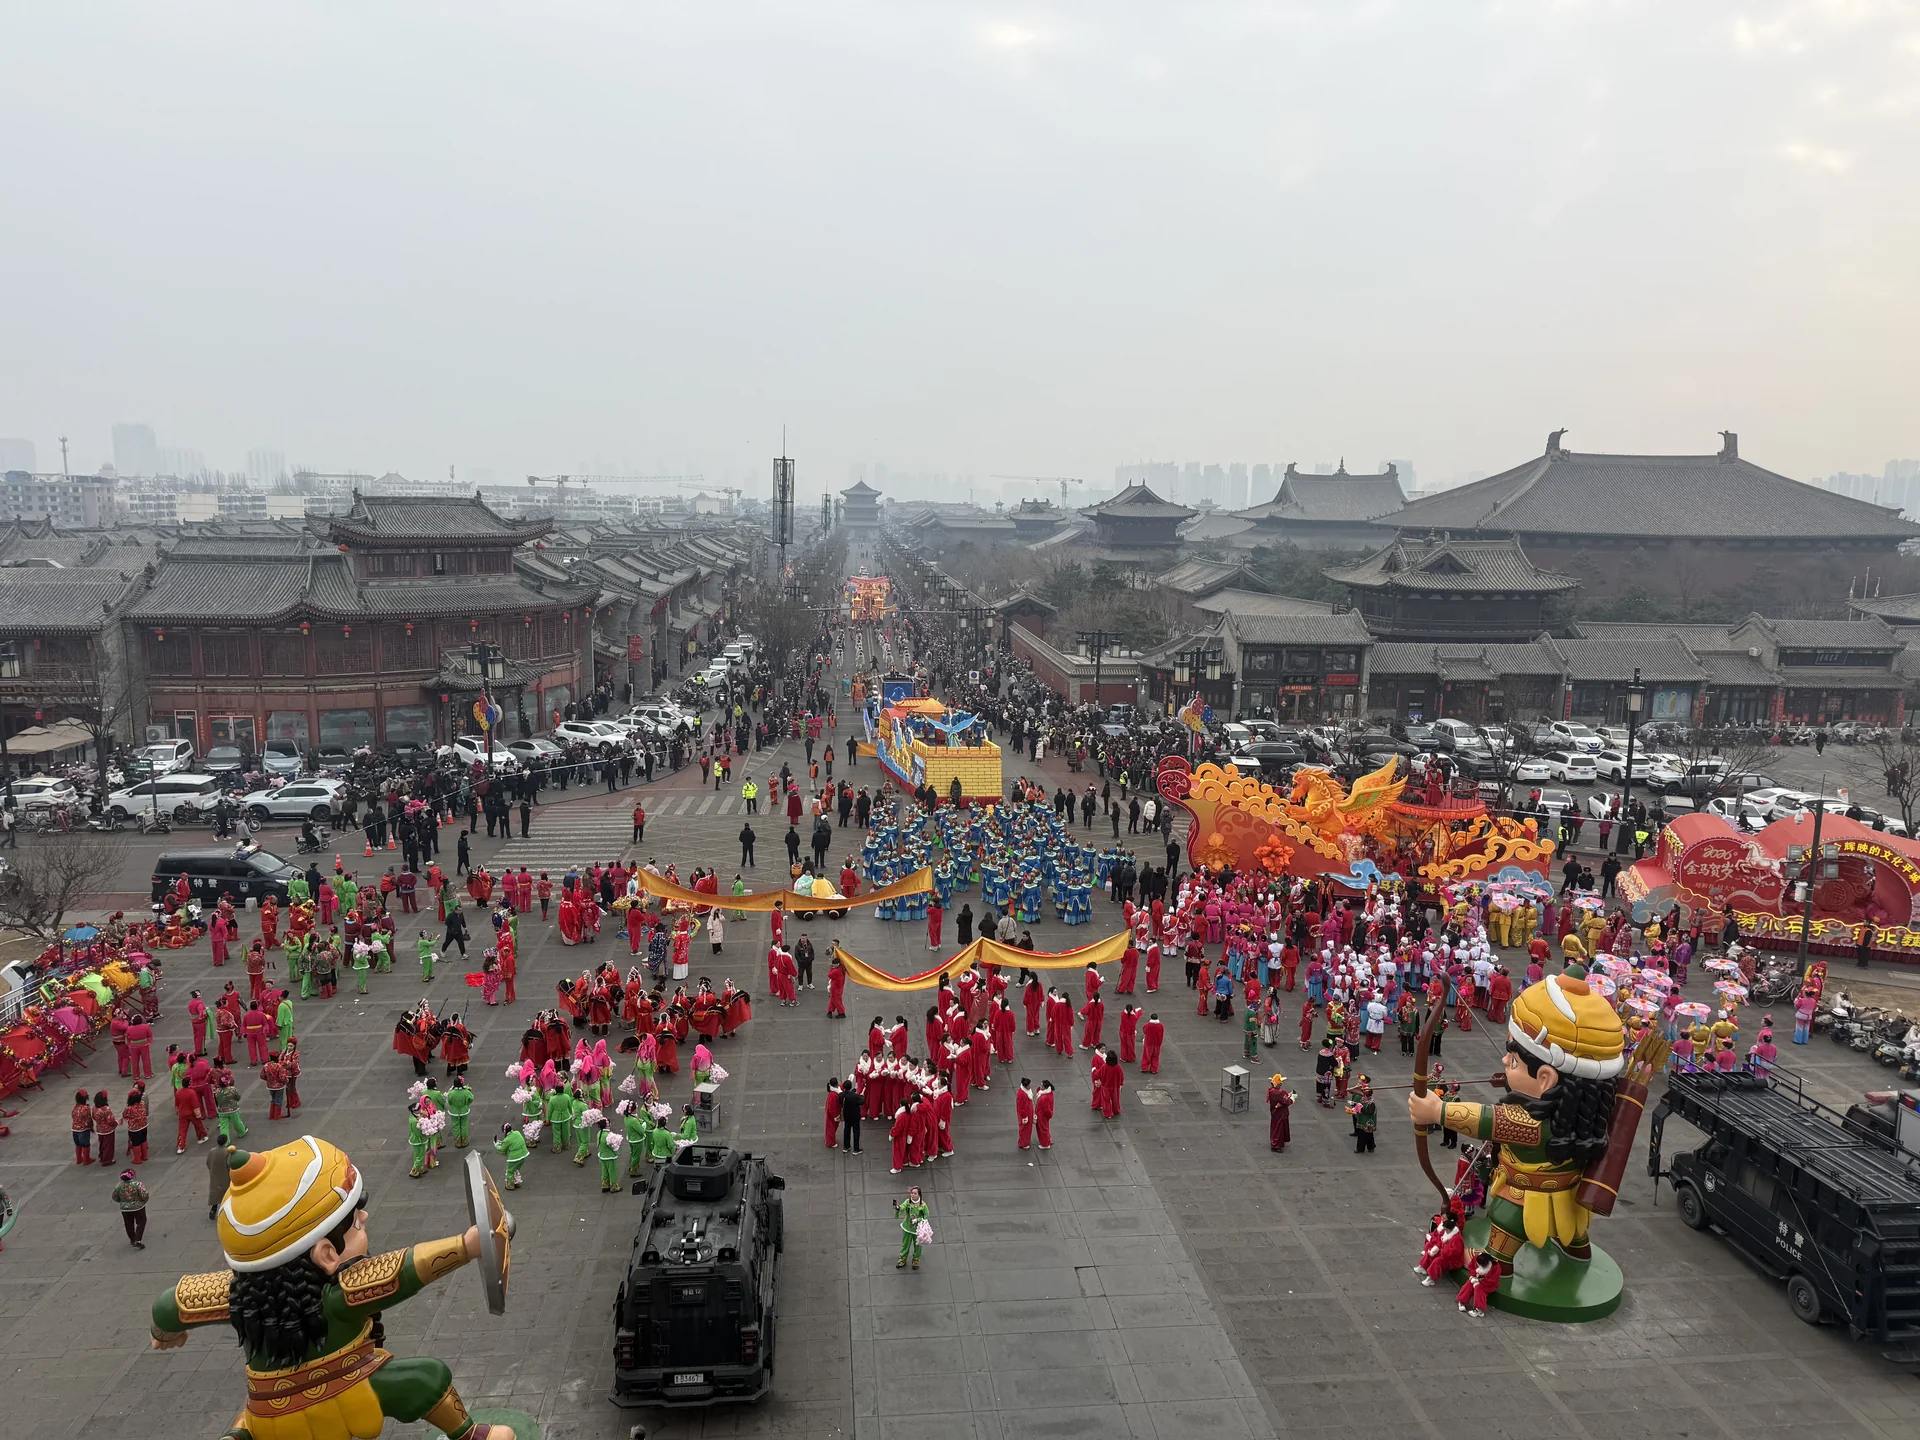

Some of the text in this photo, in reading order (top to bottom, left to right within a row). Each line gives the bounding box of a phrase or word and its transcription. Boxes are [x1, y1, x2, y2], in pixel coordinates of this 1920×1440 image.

[168, 877, 218, 888] 大特警
[1684, 860, 1734, 882] 金马贺岁
[1778, 1221, 1804, 1248] 特警
[1775, 1236, 1803, 1262] POLICE
